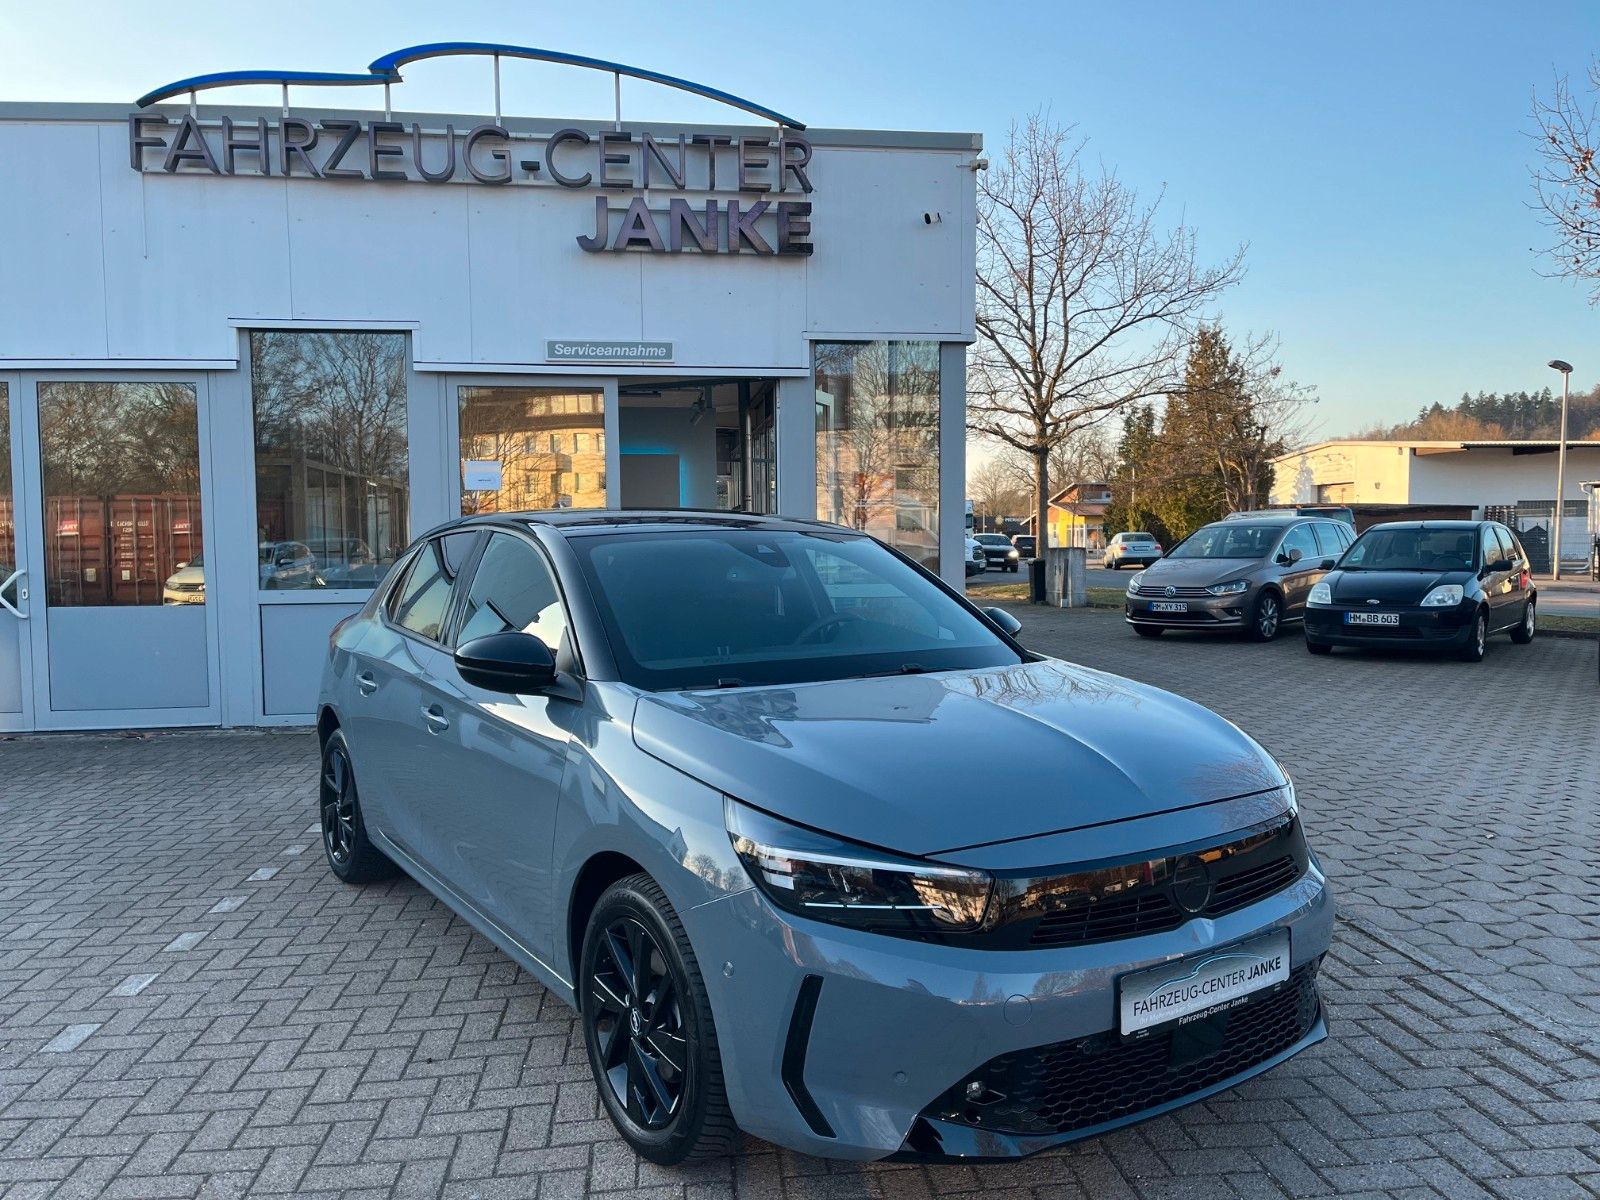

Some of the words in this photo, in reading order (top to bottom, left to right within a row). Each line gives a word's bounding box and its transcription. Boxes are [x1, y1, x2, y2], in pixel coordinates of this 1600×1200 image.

[128, 113, 813, 194] FAHRZEUG-CENTER
[576, 195, 814, 257] JANKE
[553, 343, 667, 358] Serviceannahme
[1367, 614, 1379, 623] BB
[1381, 615, 1399, 624] 603
[1133, 969, 1245, 1016] FAHRZEUG-CENTER
[1247, 956, 1281, 980] JANKE
[1178, 1000, 1231, 1026] Fahrzeug-Center
[1230, 996, 1249, 1009] Janke
